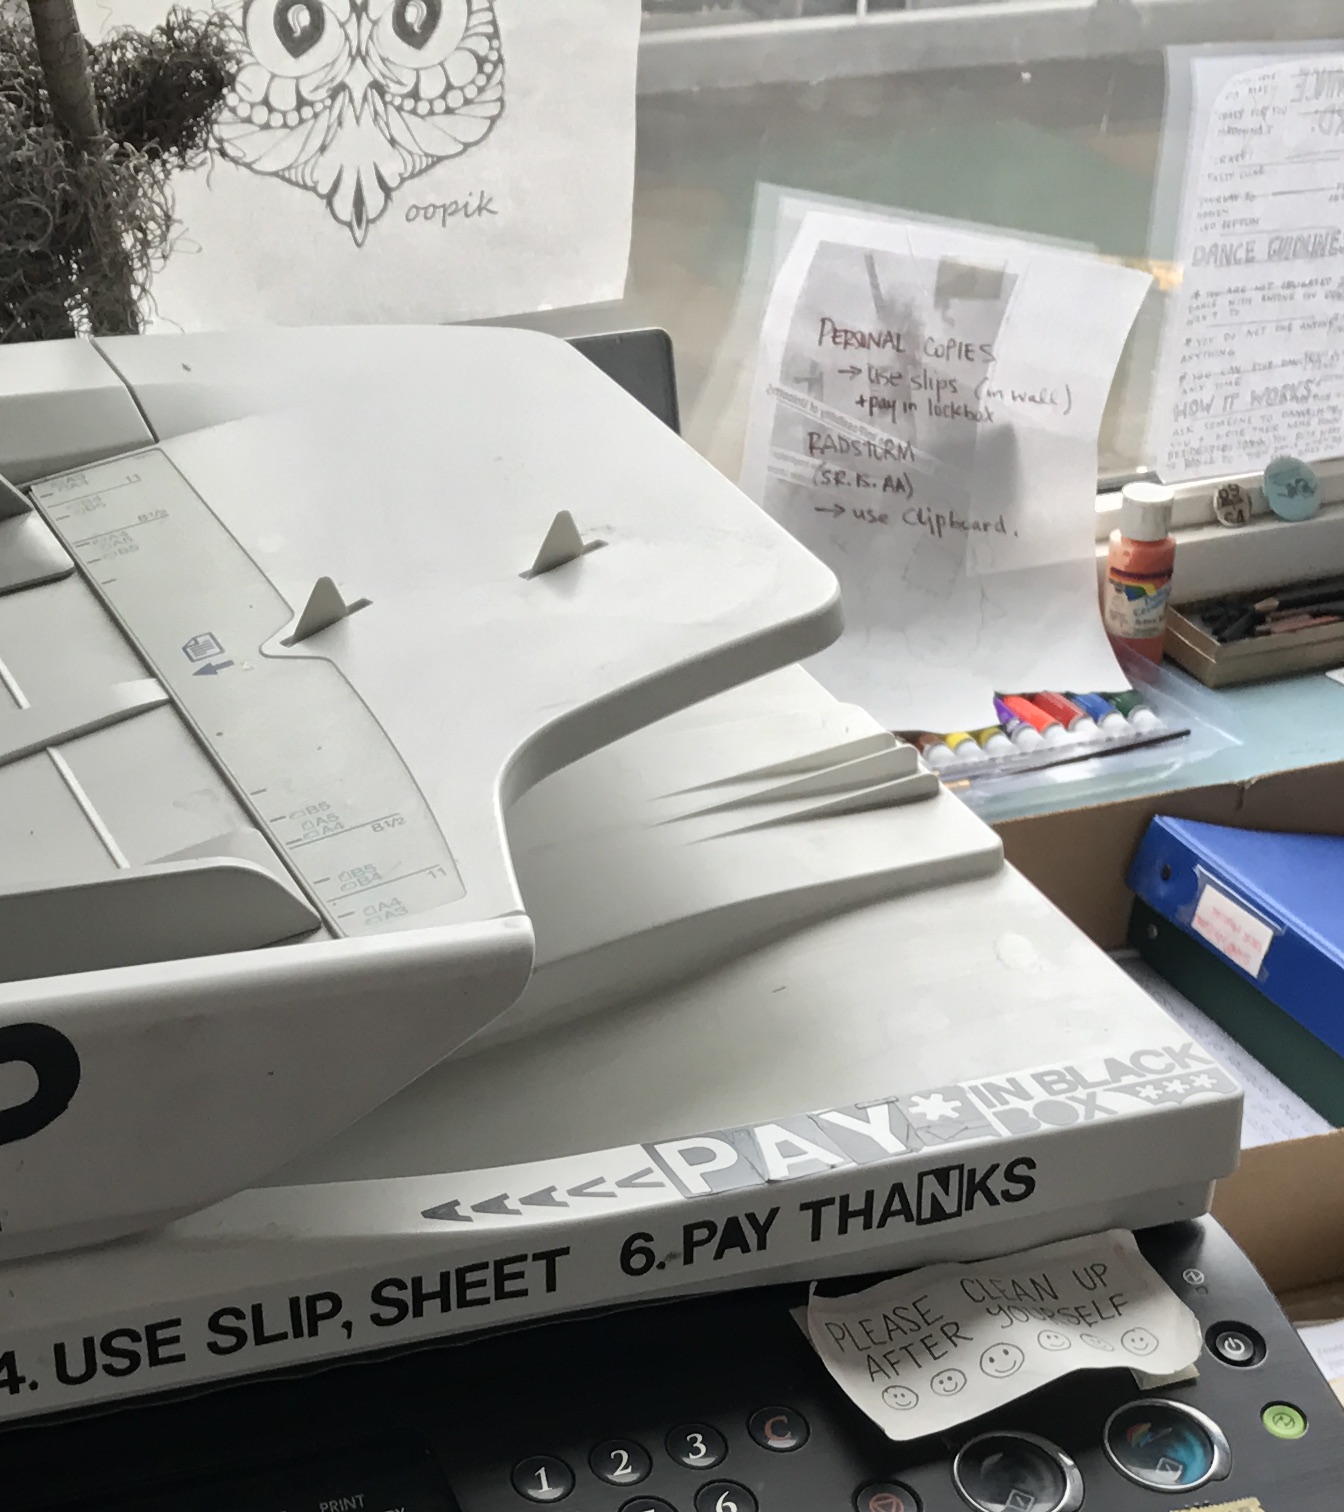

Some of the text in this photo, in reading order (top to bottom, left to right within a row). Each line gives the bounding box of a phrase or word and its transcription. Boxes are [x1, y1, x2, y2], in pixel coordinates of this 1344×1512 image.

[969, 1075, 1025, 1109] IN
[1041, 1040, 1218, 1099] BLACK
[991, 1090, 1122, 1134] BOX
[53, 1317, 187, 1386] USE
[206, 1290, 354, 1356] SLIP,
[368, 1245, 572, 1328] SHEET
[619, 1231, 669, 1278] 6.
[681, 1206, 782, 1268] PAY
[799, 1156, 1038, 1242] THANKS
[824, 1262, 1109, 1356] PLEASE CLEAN UP
[865, 1320, 975, 1384] AFTER
[687, 1432, 708, 1460] 3
[762, 1414, 791, 1443] C
[534, 1465, 552, 1491] 1
[610, 1448, 634, 1476] 2
